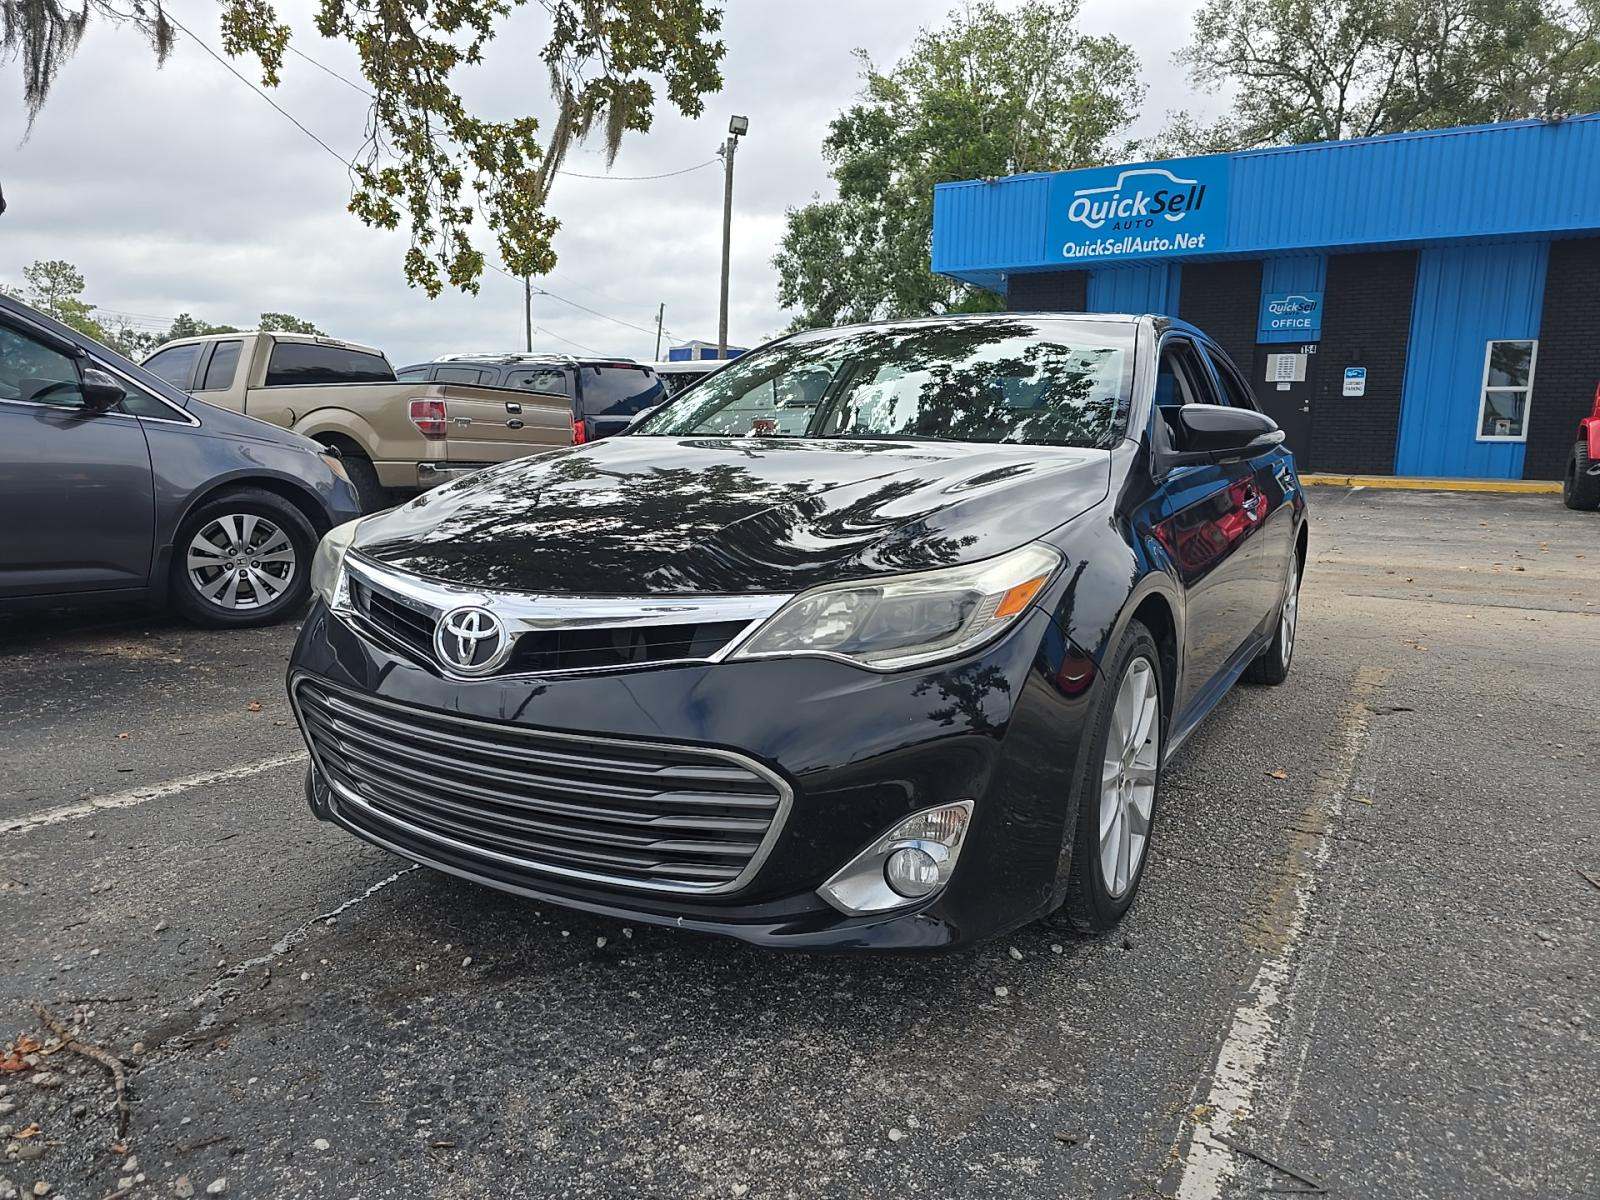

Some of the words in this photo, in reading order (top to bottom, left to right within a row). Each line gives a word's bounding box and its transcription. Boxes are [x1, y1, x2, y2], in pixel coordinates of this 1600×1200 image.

[1068, 184, 1206, 229] QuickSell
[1112, 218, 1154, 231] AUTO
[1063, 232, 1206, 257] QuickSellAuto.Net
[1268, 301, 1317, 315] QuickSell
[1271, 318, 1312, 328] OFFICE
[1300, 344, 1316, 354] 154
